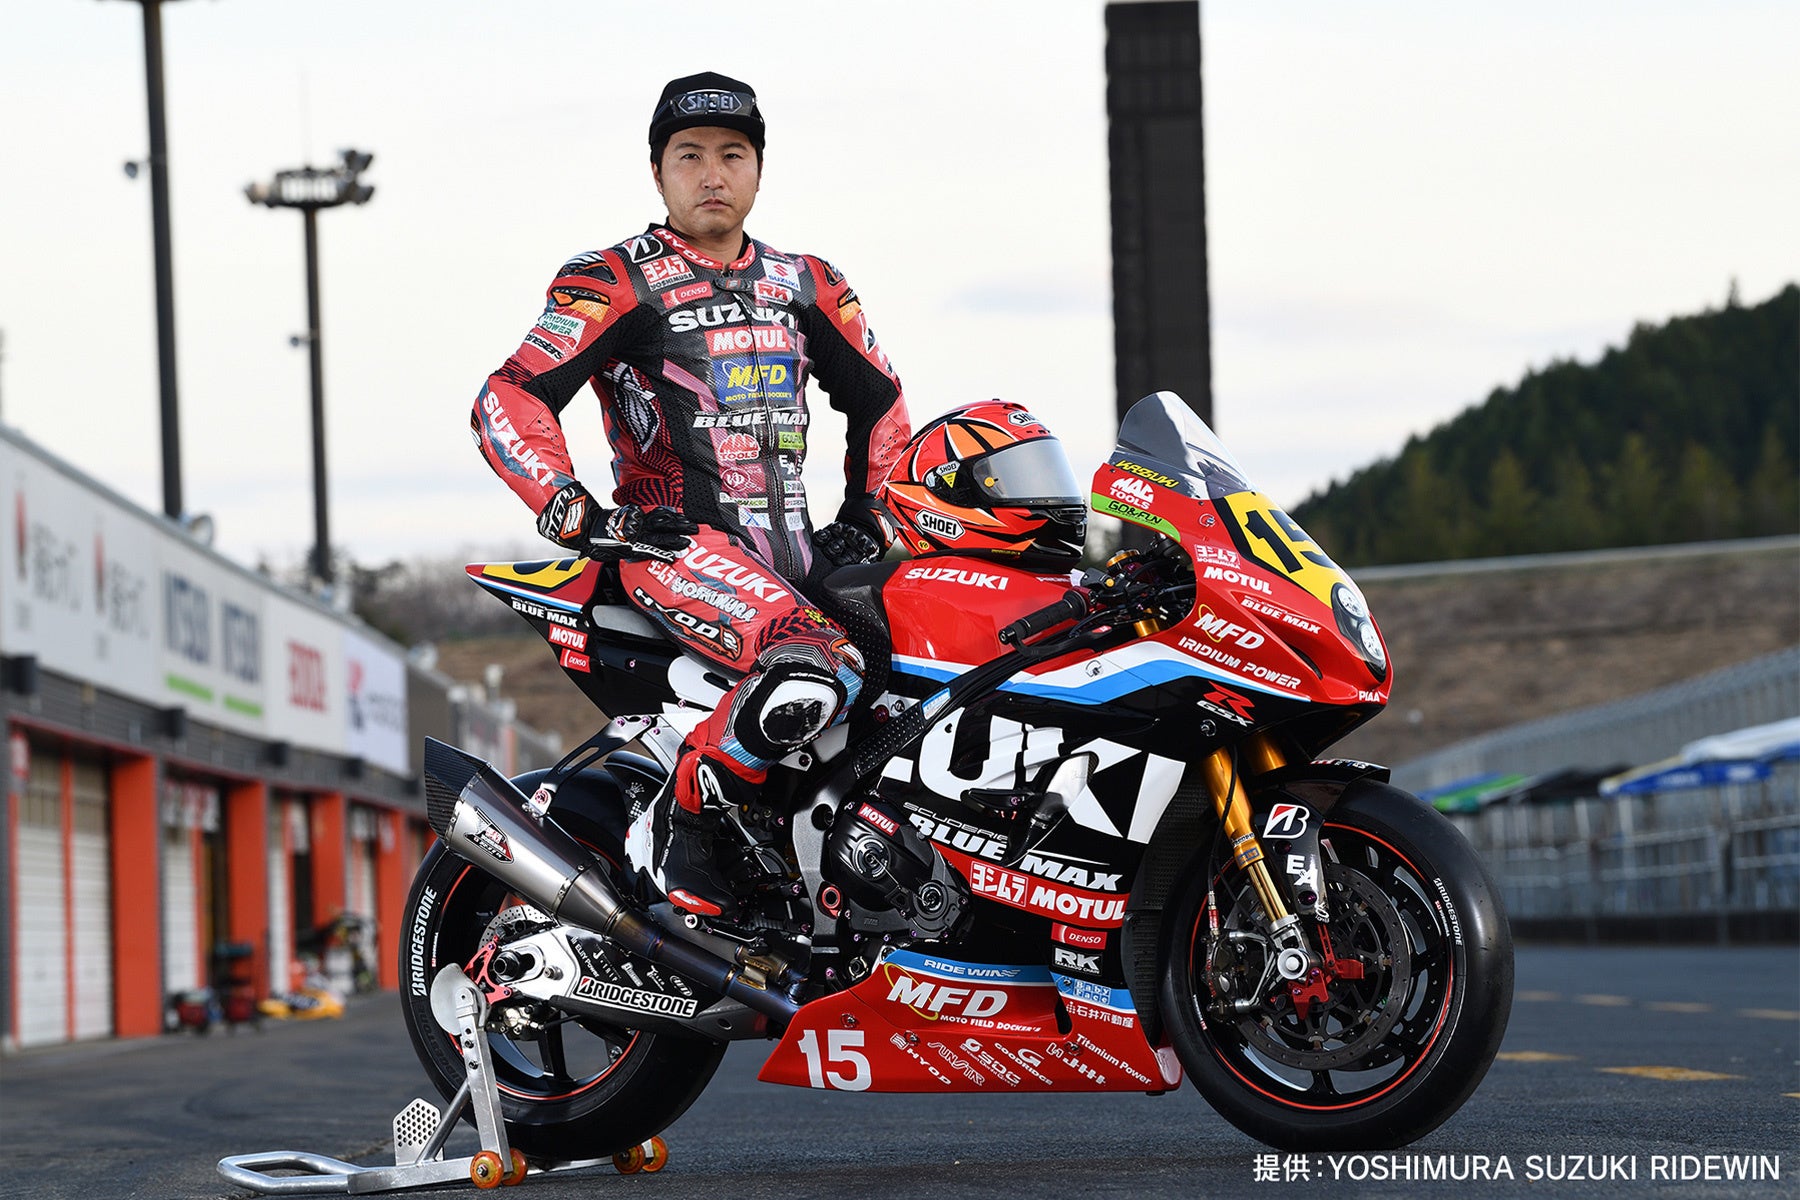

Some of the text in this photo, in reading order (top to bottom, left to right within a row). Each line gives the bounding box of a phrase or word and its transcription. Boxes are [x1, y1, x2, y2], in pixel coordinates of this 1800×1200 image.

[686, 94, 734, 110] SHOEI
[643, 255, 688, 282] ヨシムラ
[650, 273, 694, 290] YOSHIMURA
[768, 274, 799, 289] SUZUKI
[680, 286, 708, 298] DENSO
[541, 320, 572, 335] POWER
[668, 302, 795, 333] SUZUKI
[713, 329, 786, 352] MOTUL
[727, 364, 787, 388] MFD
[692, 412, 766, 428] BLUE
[482, 391, 556, 487] SUZUKI
[720, 451, 758, 460] TOOLS
[939, 463, 958, 474] SHOEI
[1109, 487, 1151, 510] TOOLS
[1111, 478, 1154, 503] MAC
[922, 515, 957, 537] SHOEI
[675, 535, 789, 603] SUZUKI
[904, 567, 1009, 591] SUZUKI
[1203, 566, 1273, 595] MOTUL
[670, 576, 757, 623] YOSHIMURA
[512, 600, 545, 619] BLUE
[546, 612, 578, 628] MAX
[634, 587, 720, 639] HYOD
[1241, 598, 1282, 619] BLUE
[1282, 612, 1322, 634] MAX
[550, 627, 585, 649] MOTUL
[1193, 612, 1265, 650] MFD
[568, 656, 587, 667] DENSO
[1178, 636, 1302, 690] IRIDIUM POWER
[1359, 690, 1380, 702] PIAA
[860, 806, 896, 834] MOTUL
[908, 812, 1123, 891] BLUE MAX
[972, 863, 1125, 921] ヨシムラ MOTUL
[1433, 877, 1463, 946] BRIDGESTONE
[411, 885, 438, 997] BRIDGESTONE
[1068, 932, 1102, 944] DENSO
[924, 958, 965, 974] RIDE
[1055, 947, 1100, 971] RK
[579, 976, 696, 1017] BRIDGESTONE
[886, 975, 1008, 1018] MFD
[940, 1014, 968, 1024] MOTO
[970, 1018, 995, 1028] FIELD
[1077, 1005, 1134, 1029] 石井不動産
[797, 1029, 873, 1091] 15
[906, 1048, 952, 1085] HYOD
[927, 1042, 986, 1086] SUNSTAR
[1076, 1033, 1120, 1066] Titanium
[1119, 1061, 1152, 1085] Power
